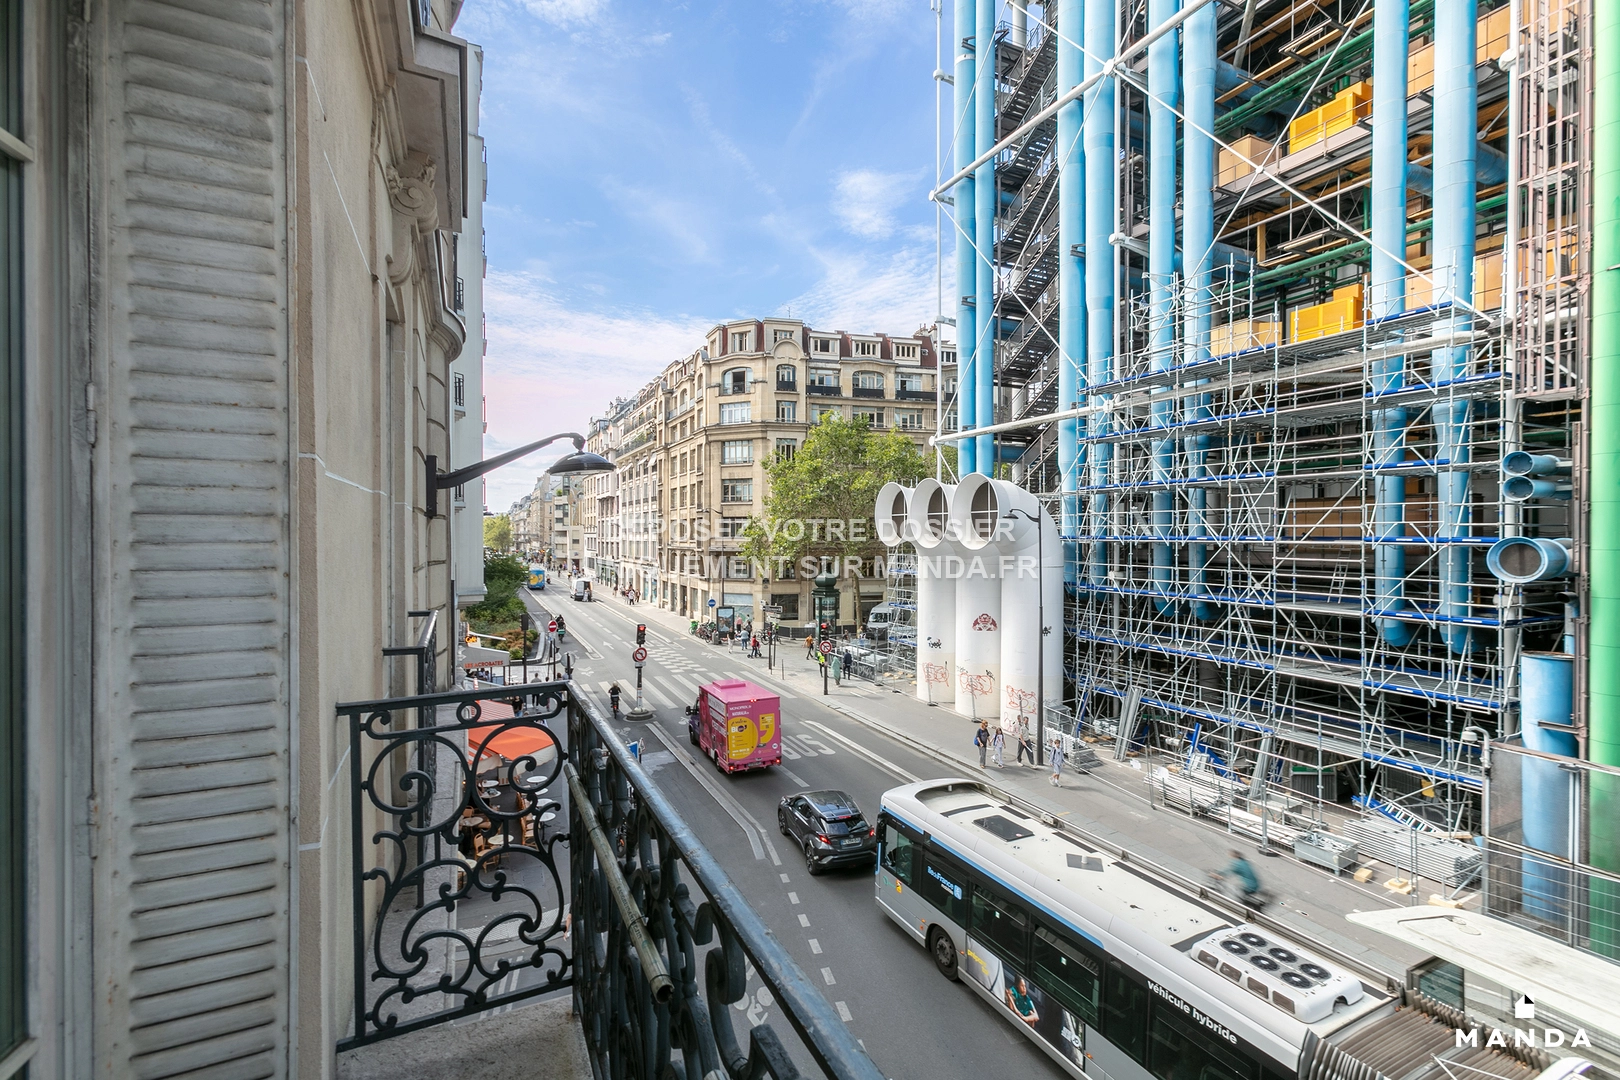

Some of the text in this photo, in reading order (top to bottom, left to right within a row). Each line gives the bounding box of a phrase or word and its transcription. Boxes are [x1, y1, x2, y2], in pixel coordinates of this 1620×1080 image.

[781, 734, 836, 760] BUS
[1147, 980, 1238, 1045] véhicule hybride
